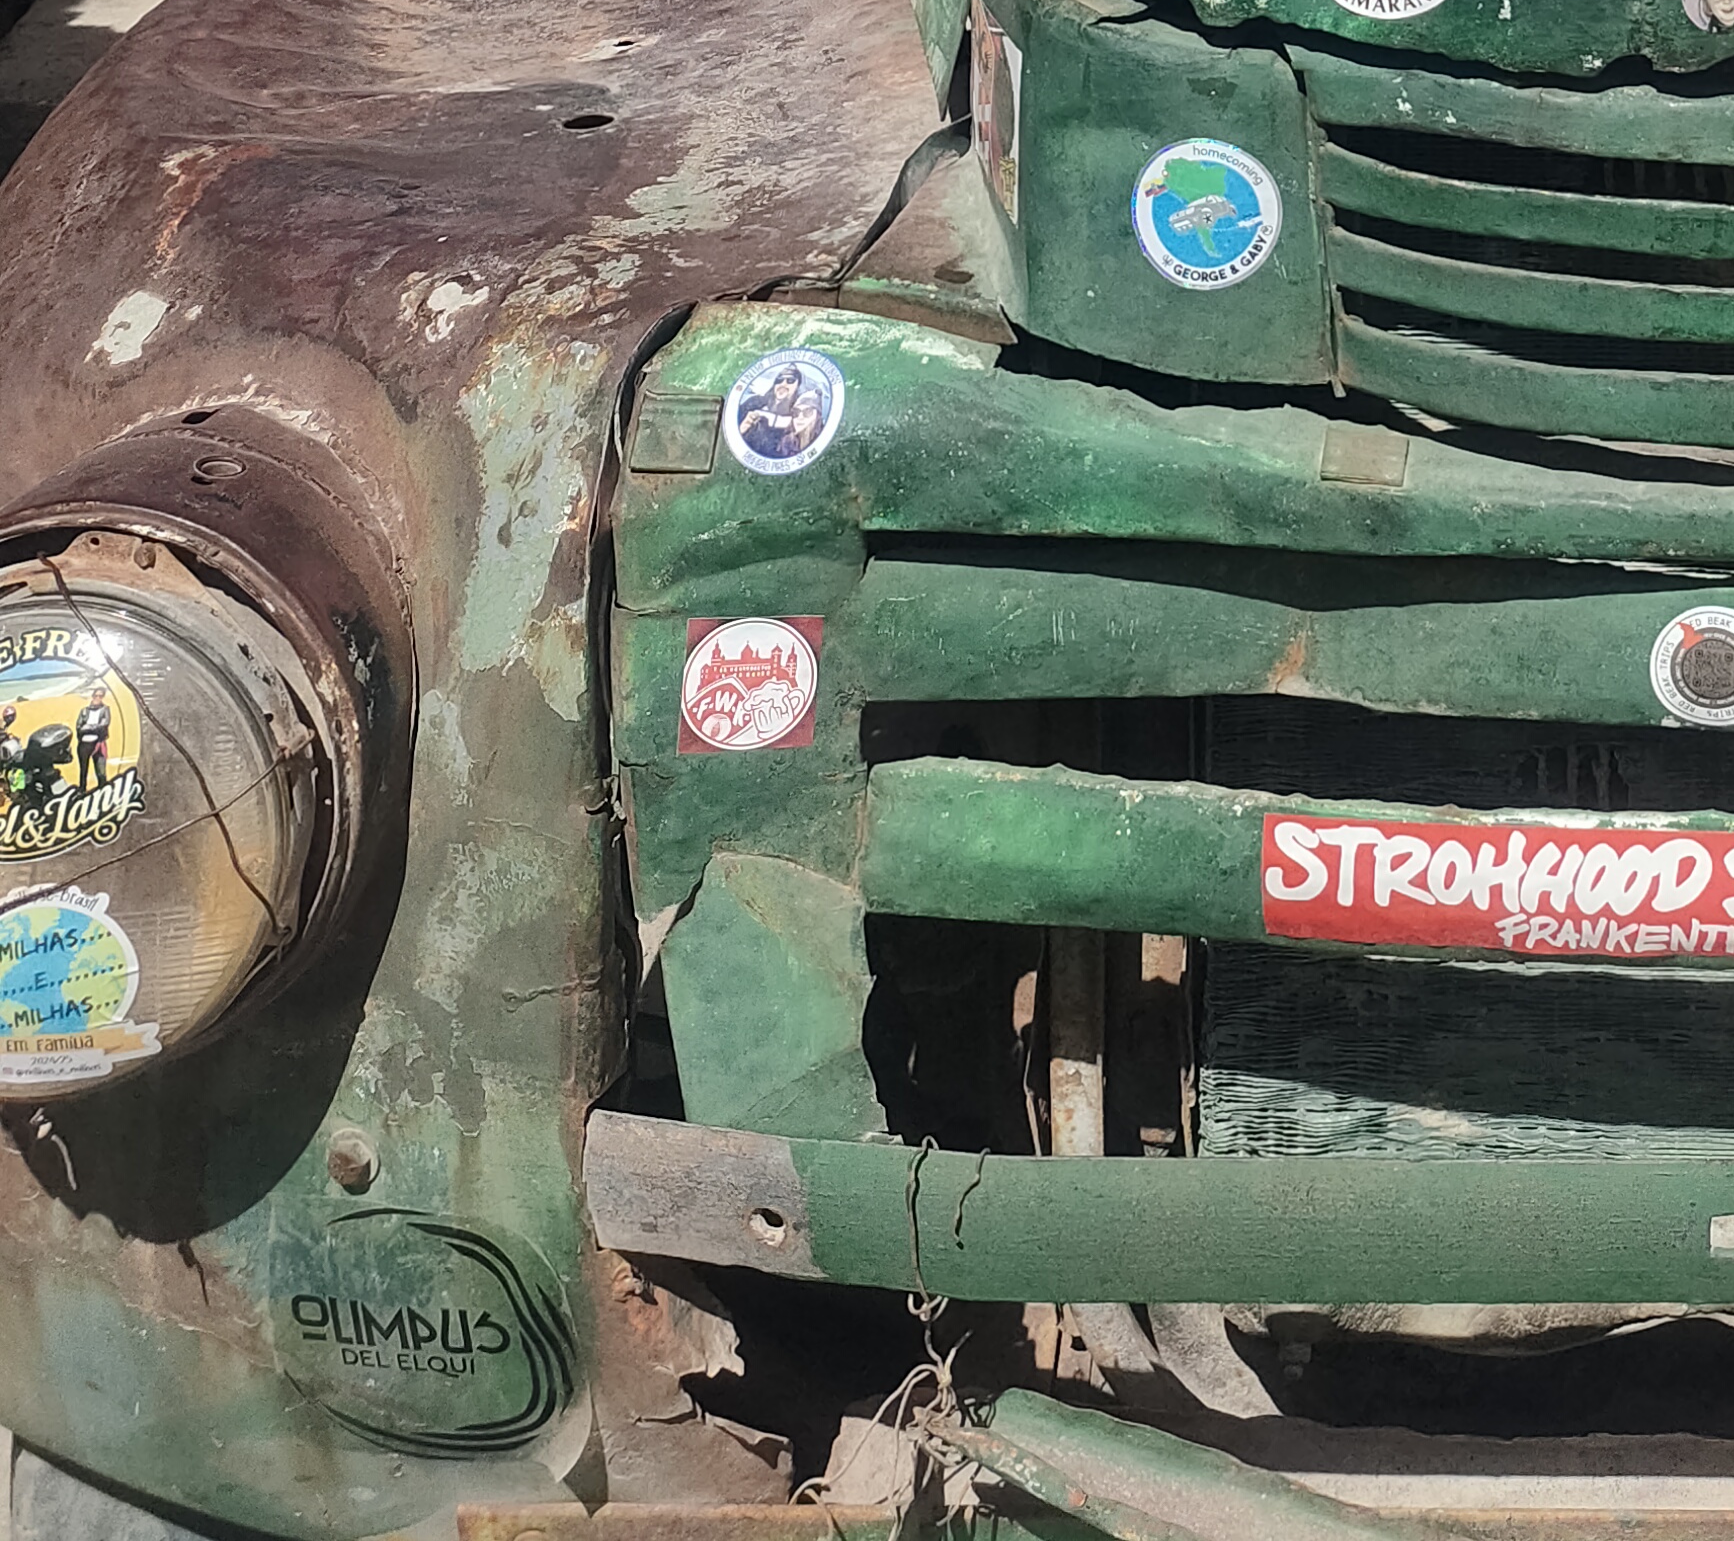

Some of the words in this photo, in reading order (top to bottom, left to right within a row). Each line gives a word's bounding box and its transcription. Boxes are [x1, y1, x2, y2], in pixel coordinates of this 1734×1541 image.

[1192, 144, 1264, 187] homecoming
[1172, 264, 1228, 282] GEORGE
[1229, 264, 1240, 276] &
[1240, 234, 1268, 267] GABY
[1688, 617, 1702, 628] ED
[1707, 616, 1733, 628] BEAK
[1659, 641, 1675, 669] TRIPS
[1661, 675, 1678, 699] BEAK
[1678, 700, 1696, 713] RED
[1264, 820, 1715, 916] STROHHOOD
[6, 1039, 29, 1053] Em
[290, 1293, 511, 1355] OLIMPUS
[341, 1347, 390, 1368] DEL
[397, 1352, 476, 1378] ELQUI
